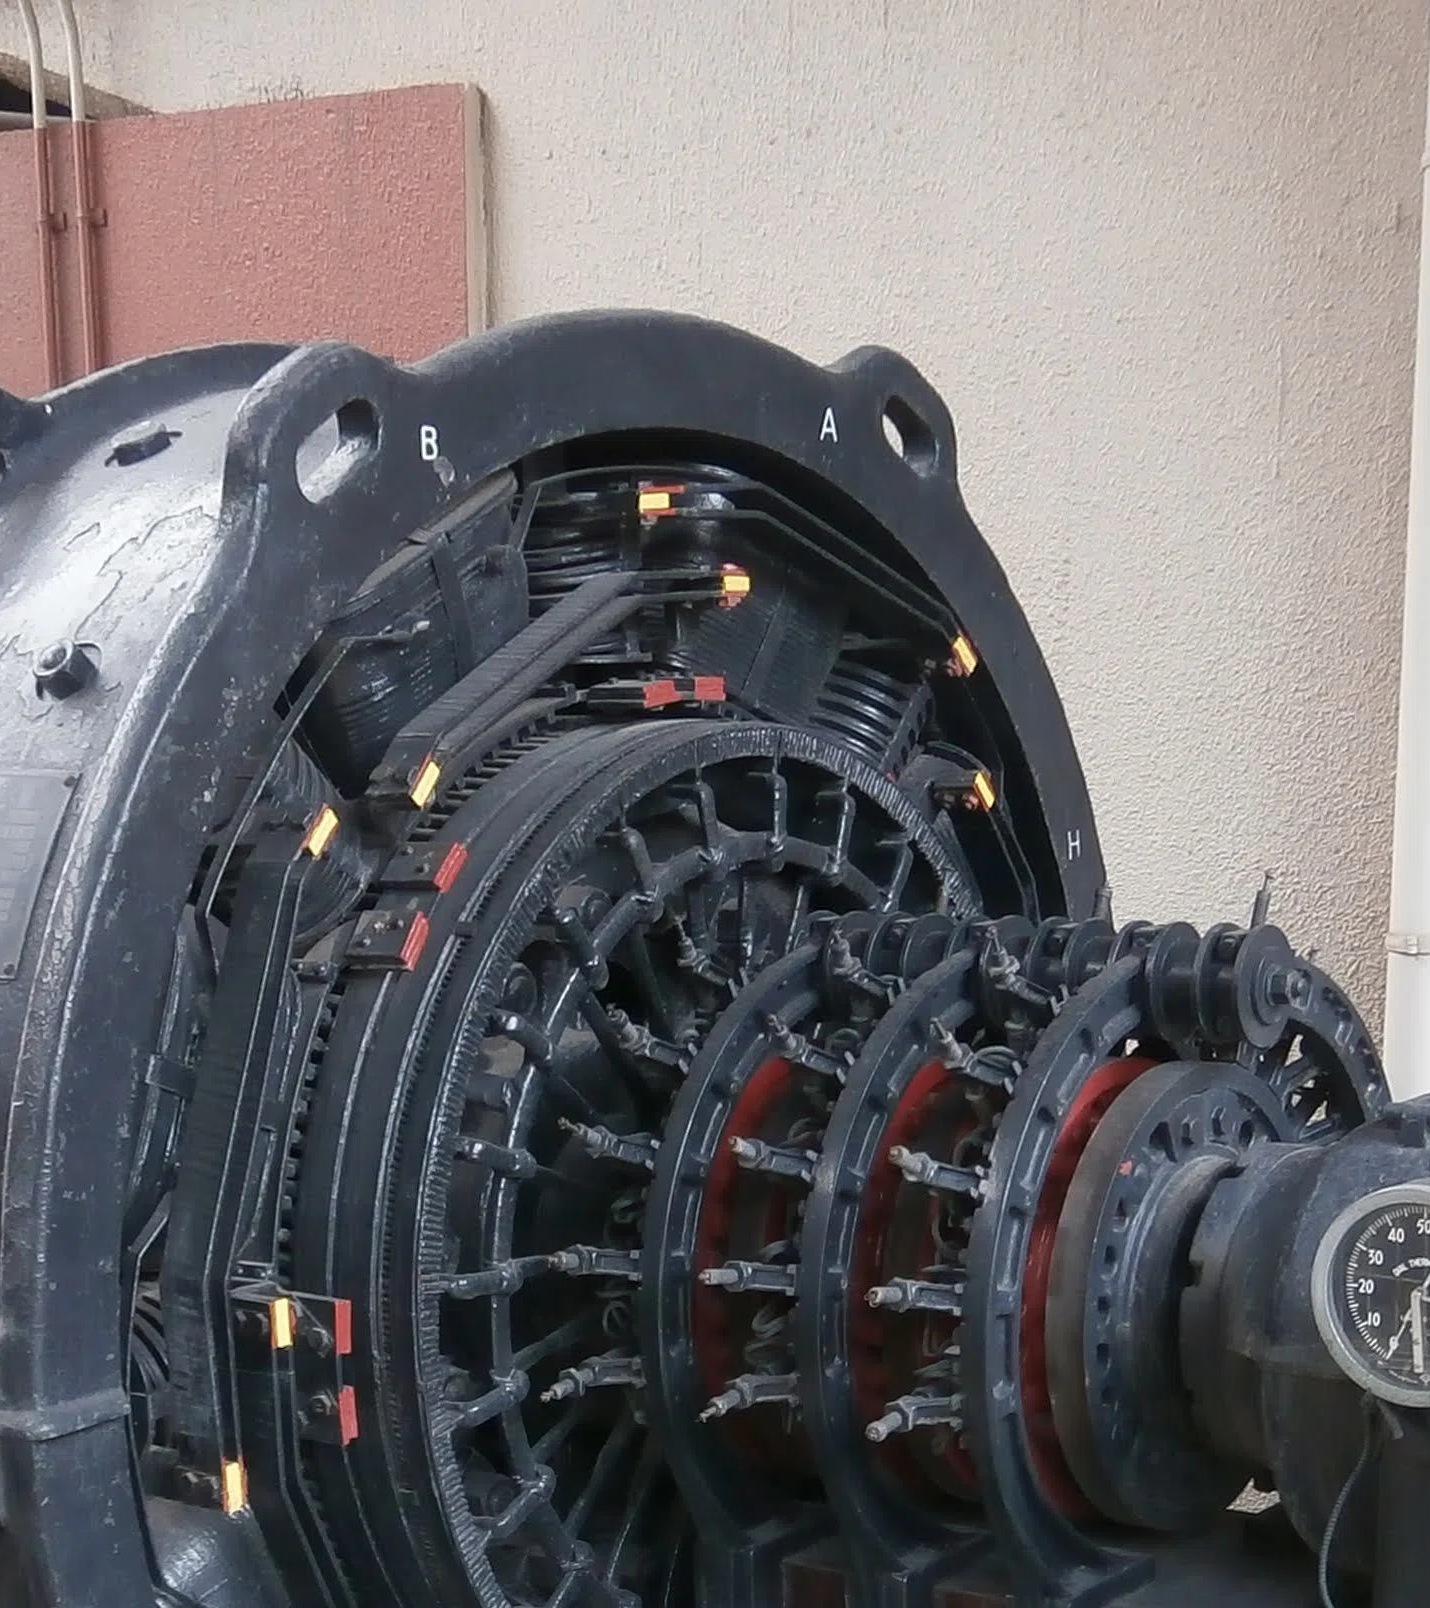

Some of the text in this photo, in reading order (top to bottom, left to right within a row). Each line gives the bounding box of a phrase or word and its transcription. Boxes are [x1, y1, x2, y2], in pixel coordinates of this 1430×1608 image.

[820, 407, 838, 443] A
[421, 425, 438, 460] B
[1388, 1228, 1405, 1243] 40
[1368, 1249, 1383, 1265] 30
[1358, 1279, 1374, 1294] 20
[1367, 1312, 1381, 1327] 10
